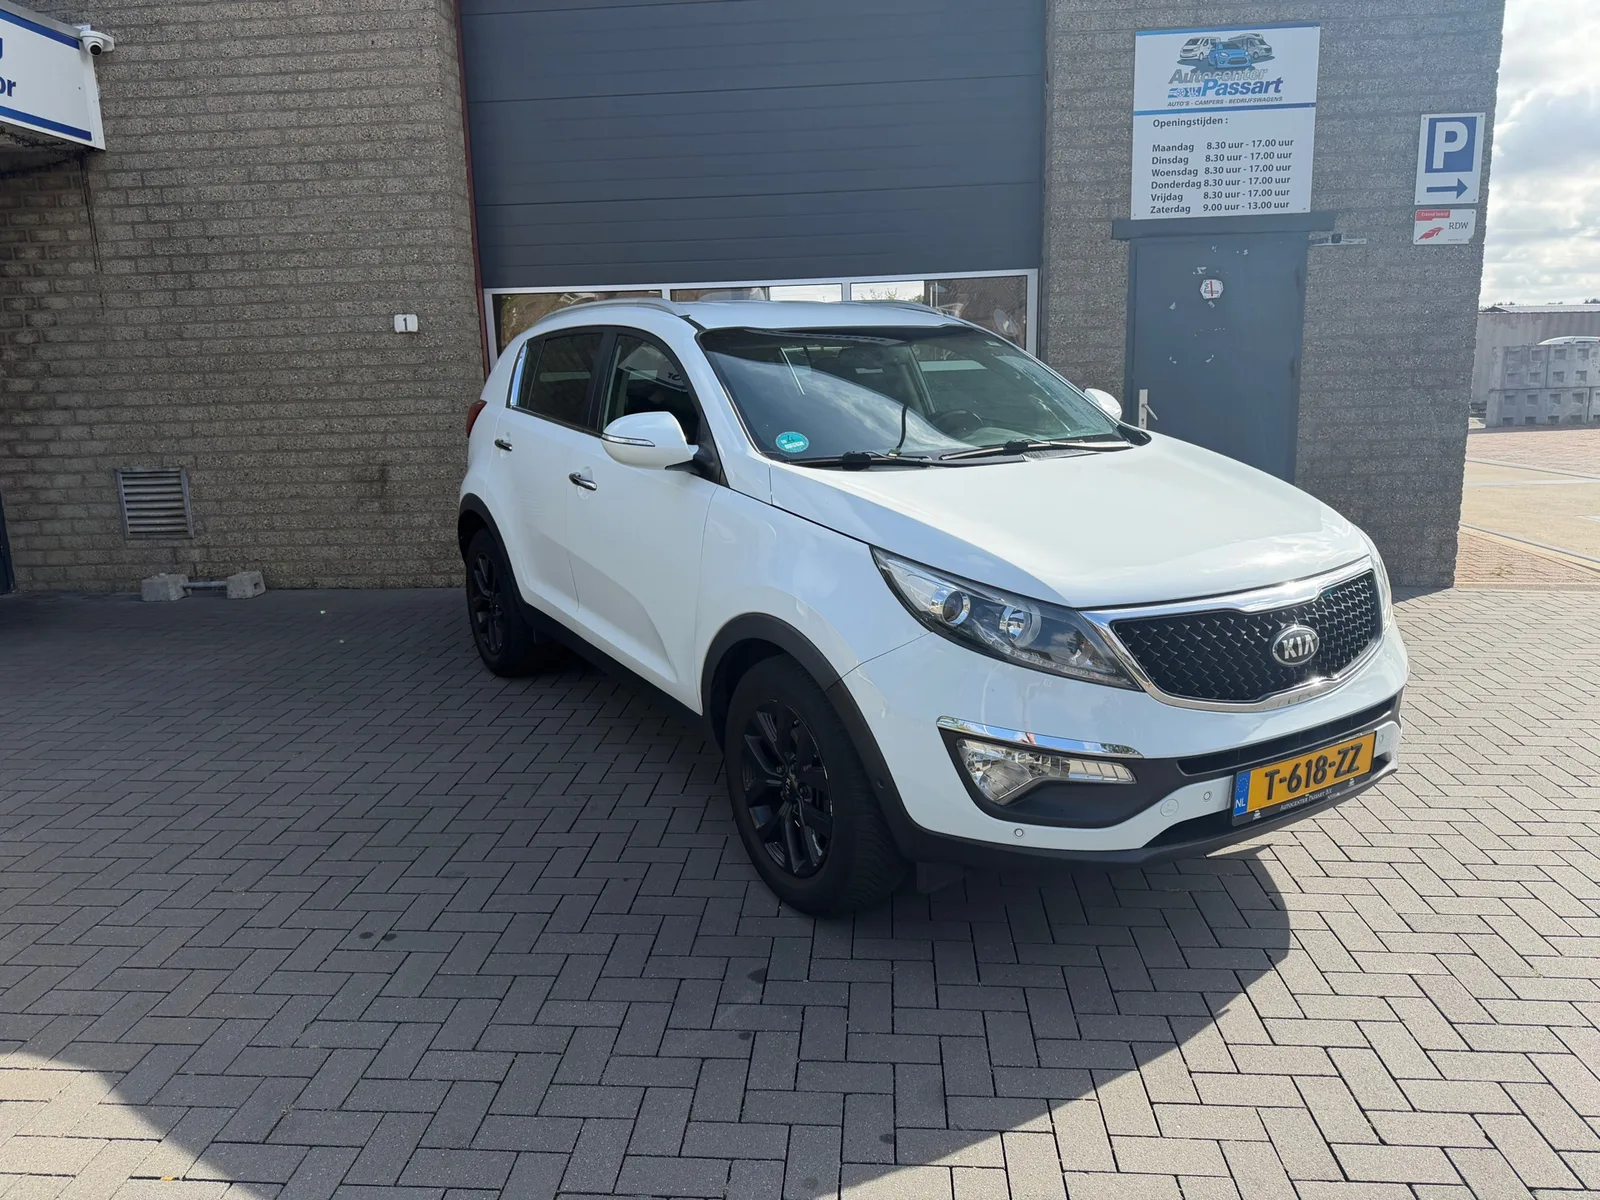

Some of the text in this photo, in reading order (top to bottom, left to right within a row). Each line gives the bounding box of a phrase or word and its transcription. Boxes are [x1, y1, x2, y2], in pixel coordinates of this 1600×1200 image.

[1168, 68, 1268, 84] Autocenter
[1201, 77, 1283, 96] Passart
[1153, 117, 1223, 128] Openingstijden
[1152, 143, 1194, 152] Maandag
[1206, 141, 1226, 150] 8.30
[1252, 139, 1276, 147] 17.00
[1433, 122, 1468, 169] P
[1152, 156, 1189, 165] Dinsdag
[1205, 154, 1224, 162] 8.30
[1250, 152, 1275, 160] 17.00
[1152, 168, 1198, 177] Woensdag
[1204, 166, 1223, 175] 8.30
[1151, 180, 1201, 189] Donderdag
[1204, 179, 1223, 187] 8.30
[1249, 177, 1273, 185] 17.00
[1151, 193, 1183, 202] Vrijdag
[1203, 191, 1222, 199] 8.30
[1248, 189, 1272, 197] 17.00
[1150, 205, 1190, 214] Zaterdag
[1203, 203, 1222, 212] 9.00
[403, 317, 408, 330] 1
[1283, 634, 1314, 660] KIA
[1265, 743, 1364, 800] T-618-ZZ
[1236, 796, 1246, 808] NL
